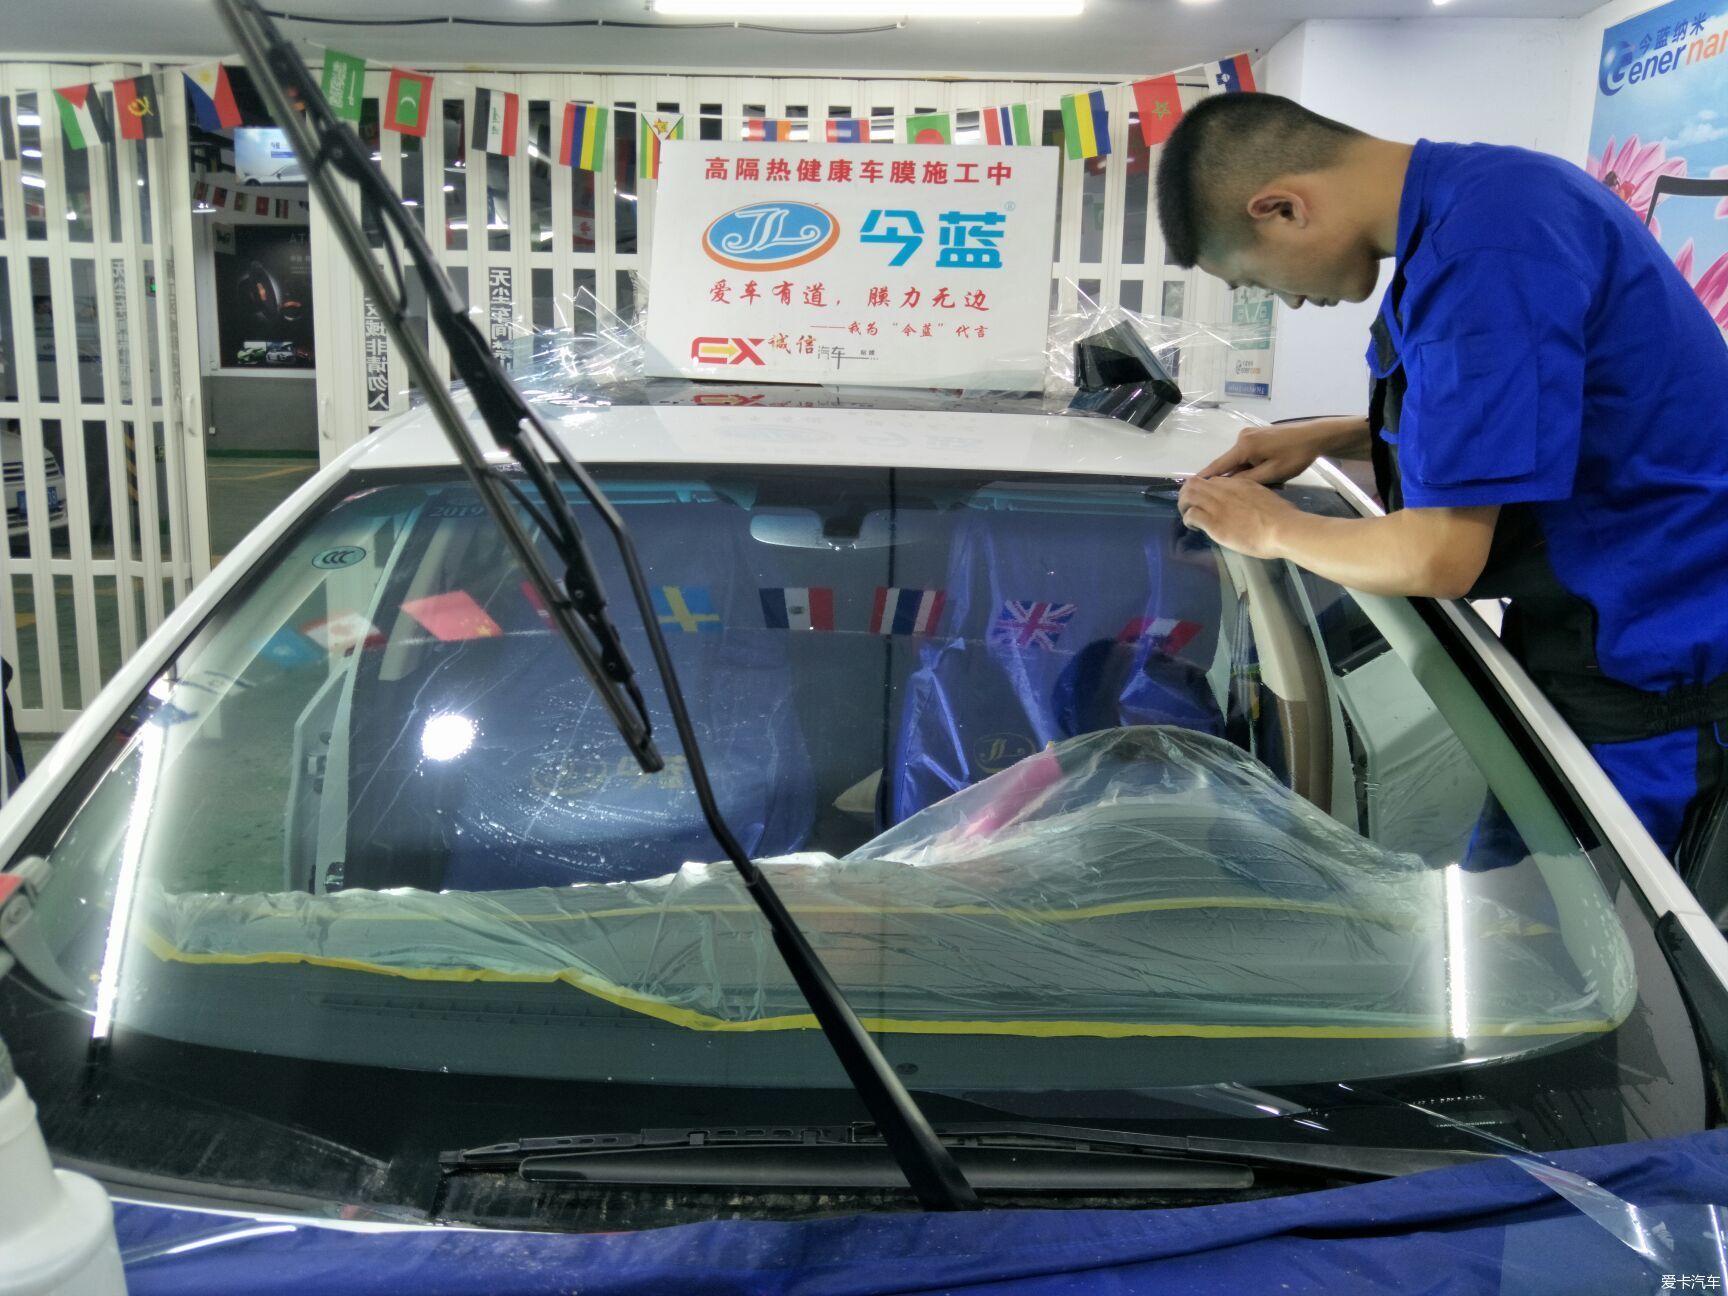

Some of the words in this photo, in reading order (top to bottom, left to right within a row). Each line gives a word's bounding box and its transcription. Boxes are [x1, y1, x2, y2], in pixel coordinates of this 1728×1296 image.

[1640, 12, 1706, 55] 今蓝纳米
[704, 157, 1013, 187] 高隔热健康车膜施工中
[859, 209, 1007, 269] 今蓝
[709, 279, 992, 312] 爱车有道，膜力无边
[429, 506, 485, 518] 2019
